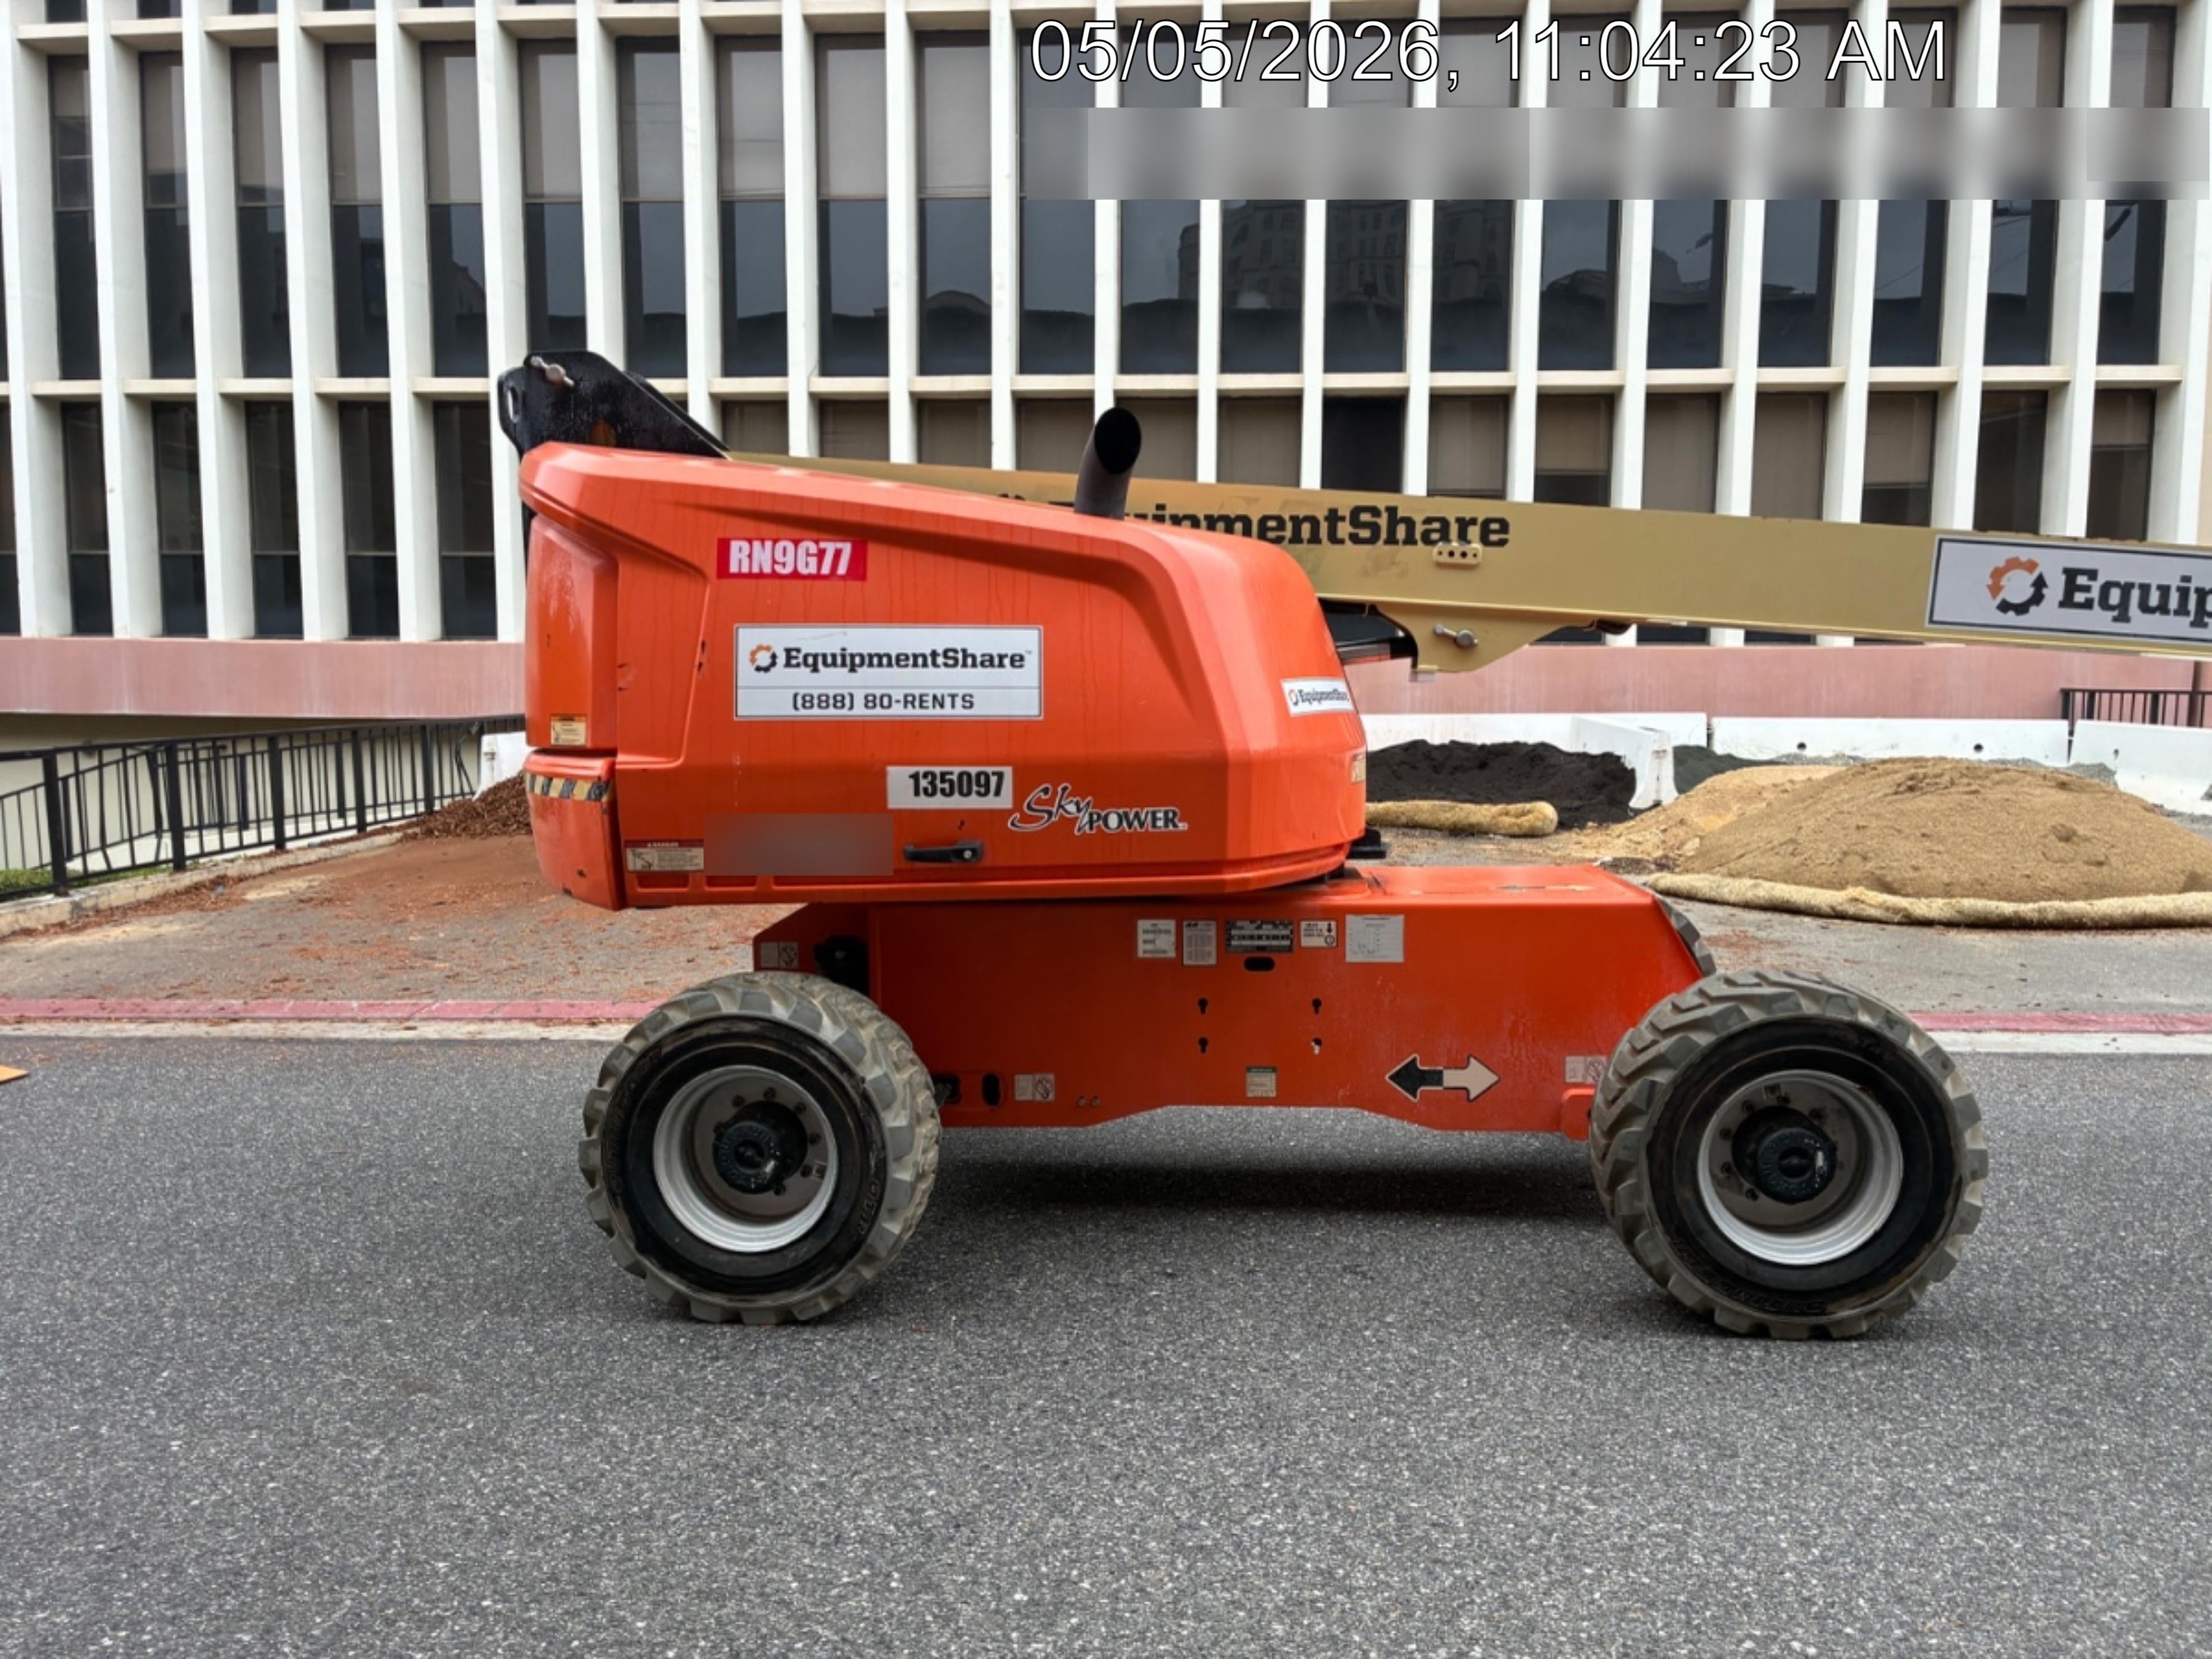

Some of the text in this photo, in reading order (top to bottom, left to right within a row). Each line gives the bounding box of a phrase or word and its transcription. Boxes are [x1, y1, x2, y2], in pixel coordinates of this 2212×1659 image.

[729, 539, 852, 575] RN9G77
[783, 647, 1026, 673] EquipmentShare
[792, 692, 975, 712] (888) 80-RENTS
[908, 771, 1005, 797] 135097
